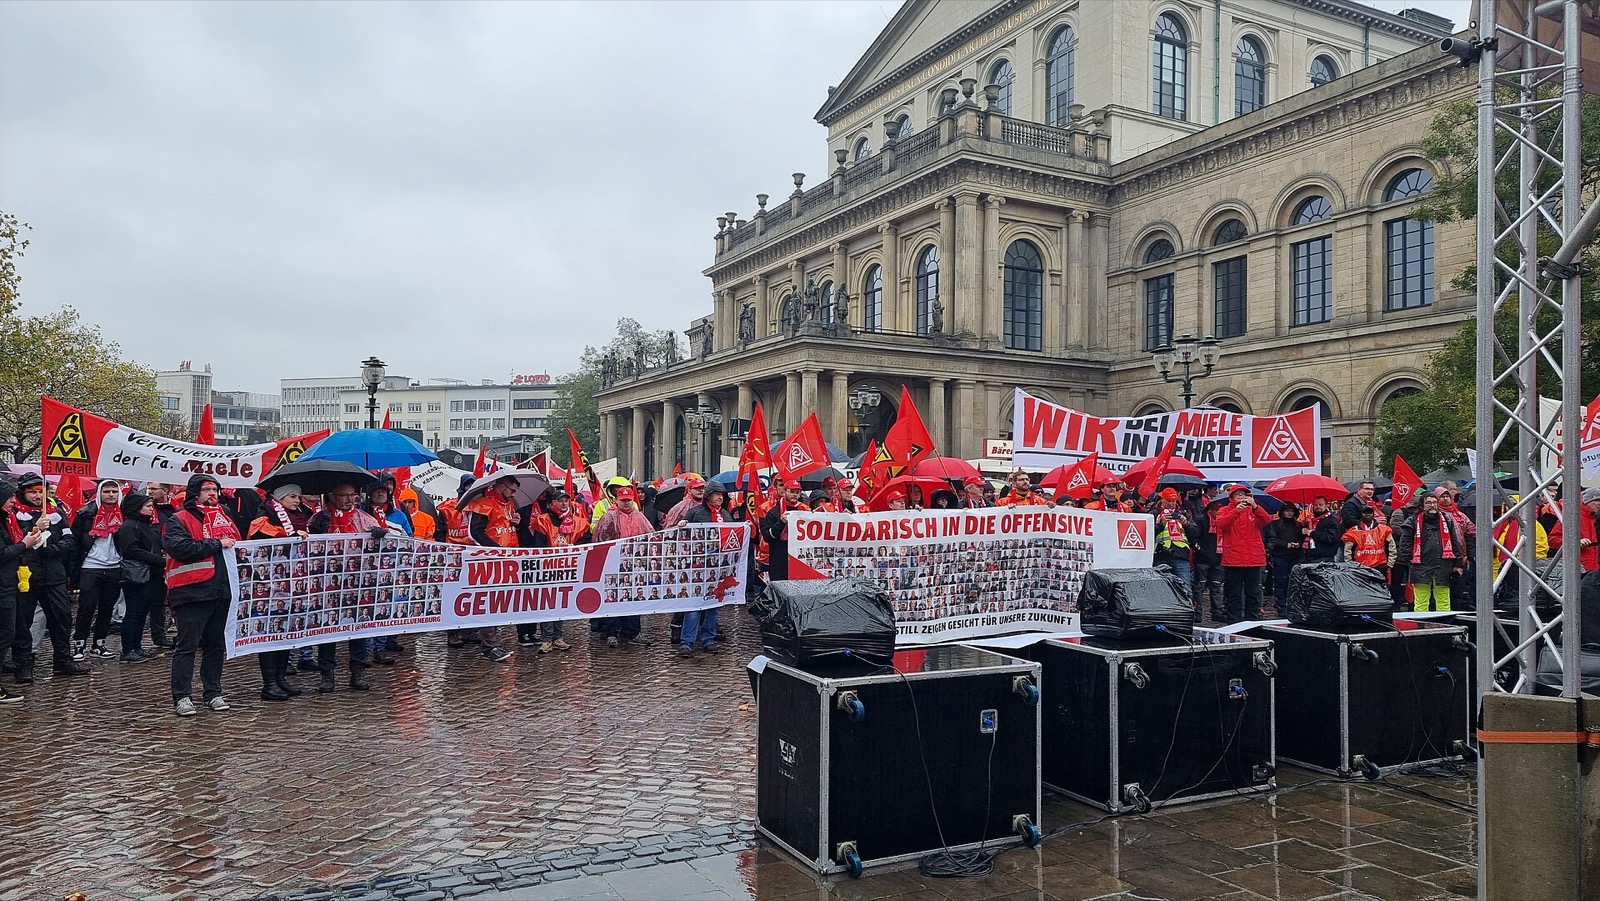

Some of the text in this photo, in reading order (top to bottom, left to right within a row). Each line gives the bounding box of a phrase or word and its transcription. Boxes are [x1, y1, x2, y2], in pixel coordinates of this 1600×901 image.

[1023, 397, 1121, 454] WIR
[1177, 411, 1243, 437] MIELE
[1122, 433, 1149, 457] IN
[55, 462, 92, 476] Metall
[113, 450, 253, 478] der Fa. Miele
[796, 513, 1094, 542] SOLIDARISCH IN DIE OFFENSIVE
[468, 560, 520, 586] WIR
[521, 557, 578, 571] BEI MIELE
[521, 569, 577, 583] IN LEHRTE
[921, 622, 946, 634] ZEIGEN
[948, 617, 979, 630] GESICHT
[981, 615, 997, 627] FÜR
[999, 613, 1026, 625] UNSERE
[1027, 612, 1073, 626] ZUKUNFT
